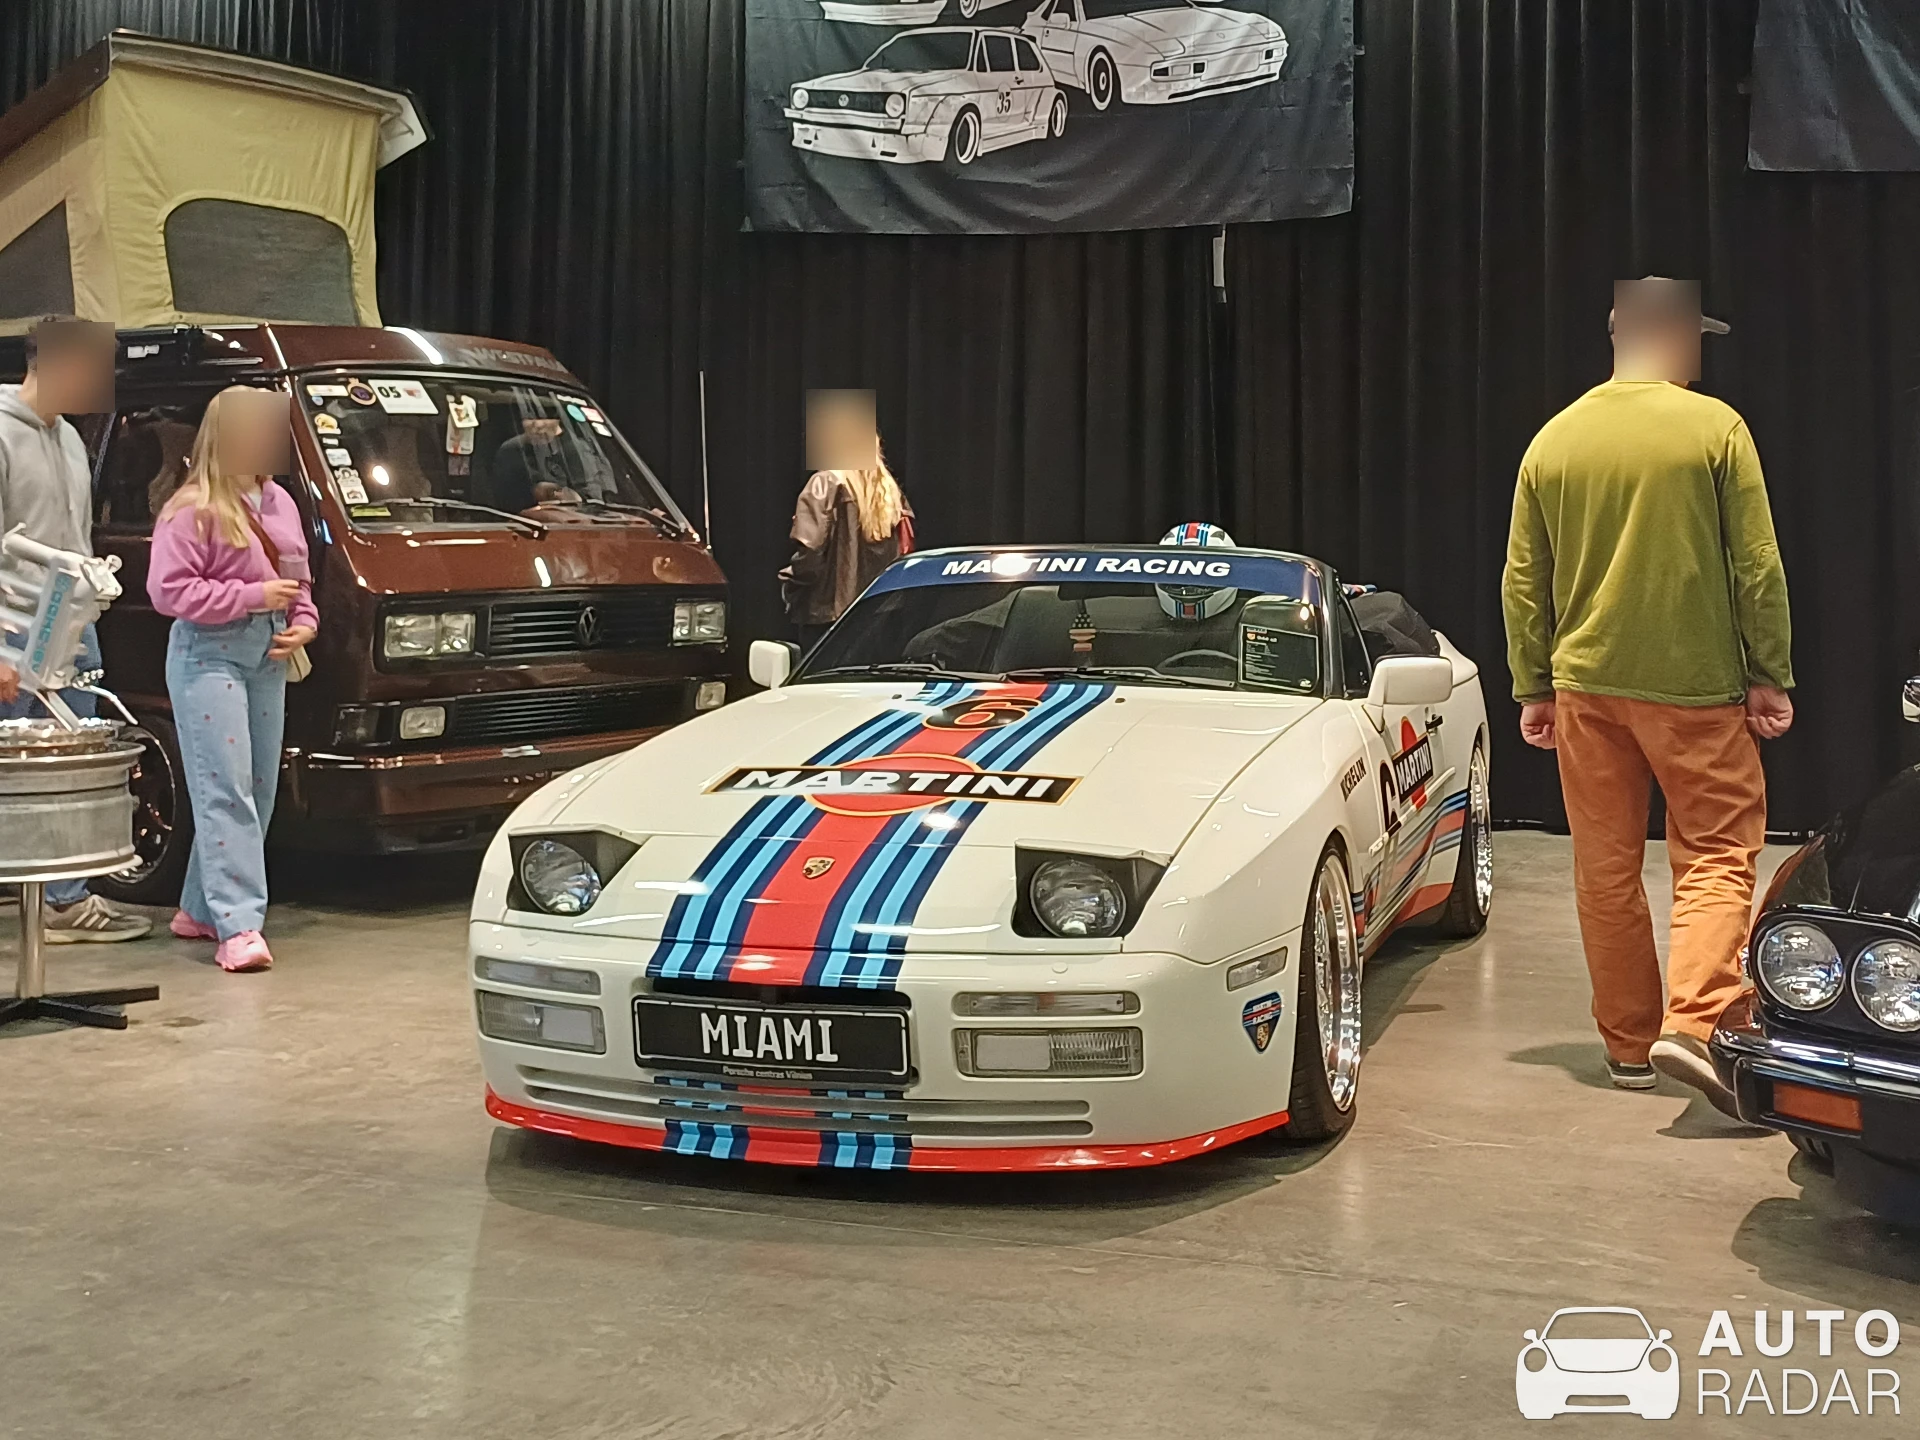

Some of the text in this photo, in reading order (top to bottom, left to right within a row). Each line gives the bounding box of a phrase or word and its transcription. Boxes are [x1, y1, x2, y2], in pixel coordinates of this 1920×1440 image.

[997, 92, 1011, 114] 35
[377, 386, 402, 398] 05
[941, 557, 1231, 577] MATINI RACING
[1395, 742, 1432, 796] MARTINI
[732, 770, 1056, 798] MARTINI
[700, 1012, 839, 1063] MIAMI
